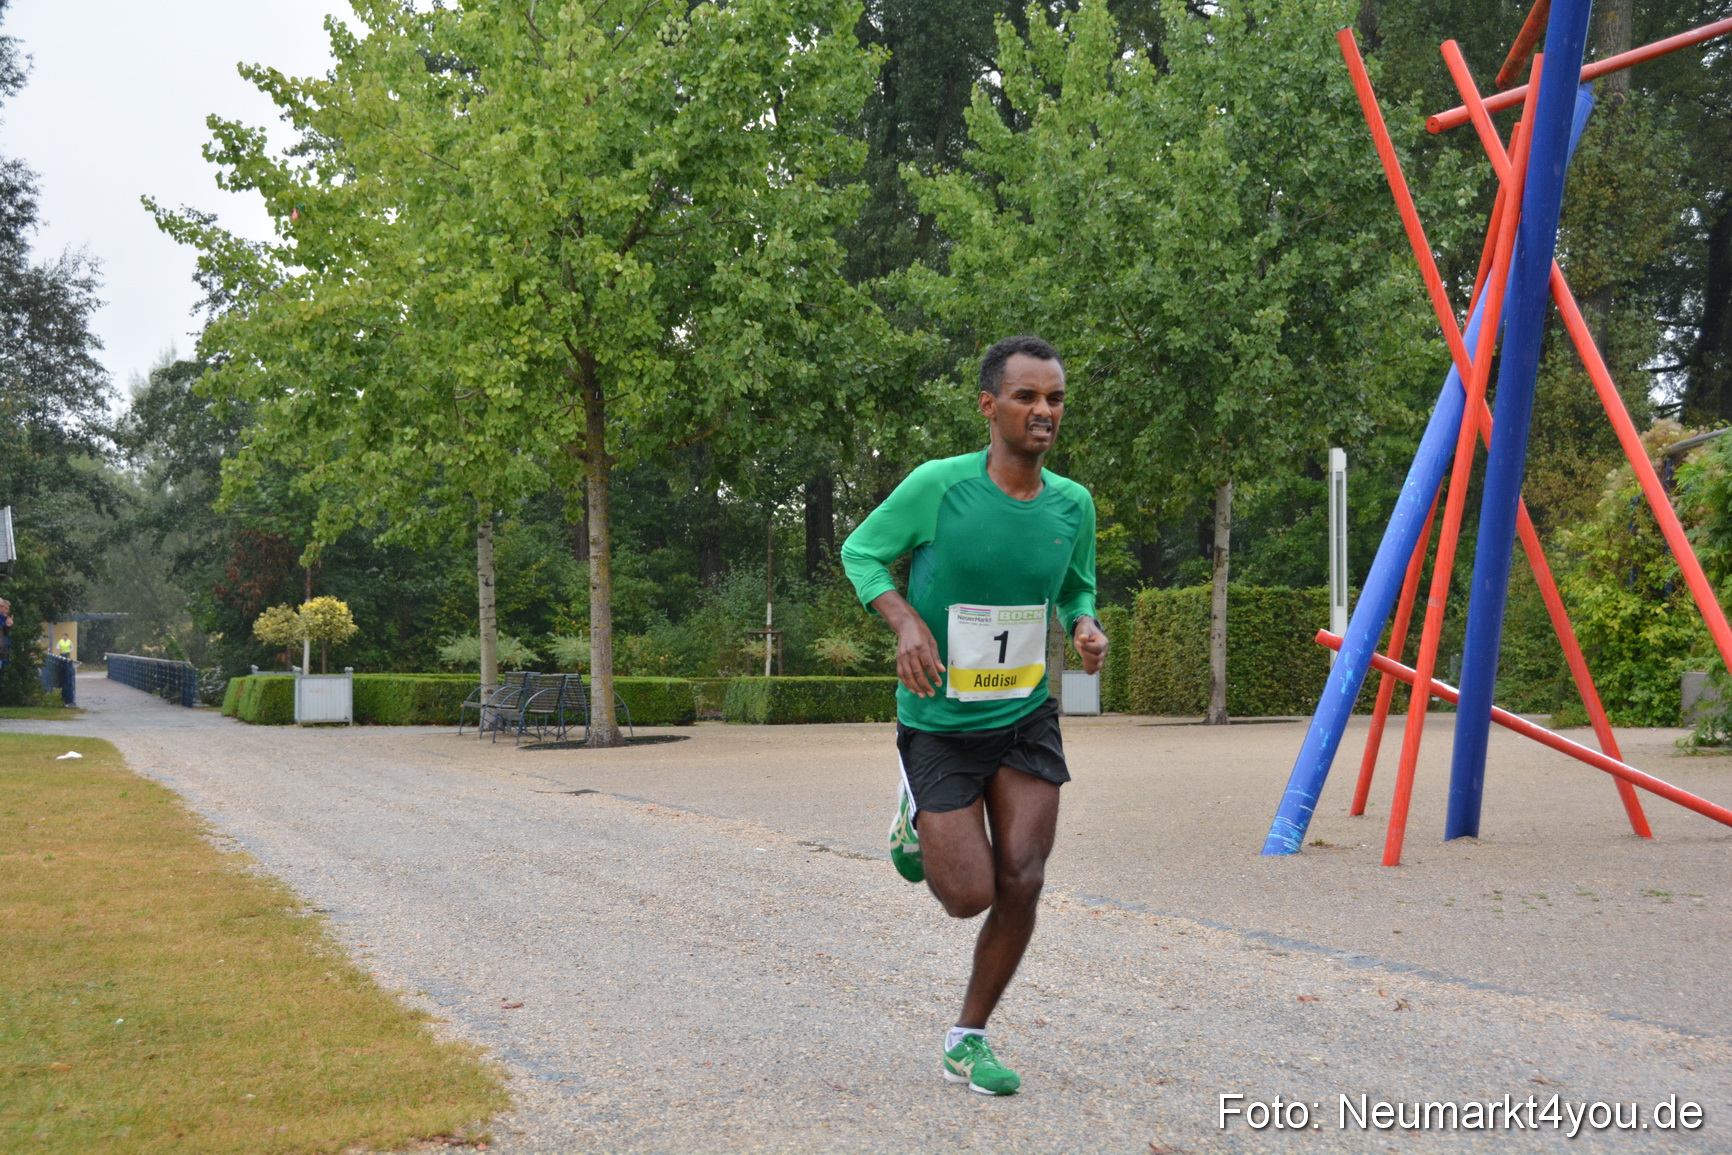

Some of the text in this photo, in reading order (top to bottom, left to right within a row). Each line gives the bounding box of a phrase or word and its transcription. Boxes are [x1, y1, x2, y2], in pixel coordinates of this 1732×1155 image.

[998, 609, 1044, 622] BOCK
[994, 630, 1009, 664] 1
[974, 674, 1017, 688] Addisu
